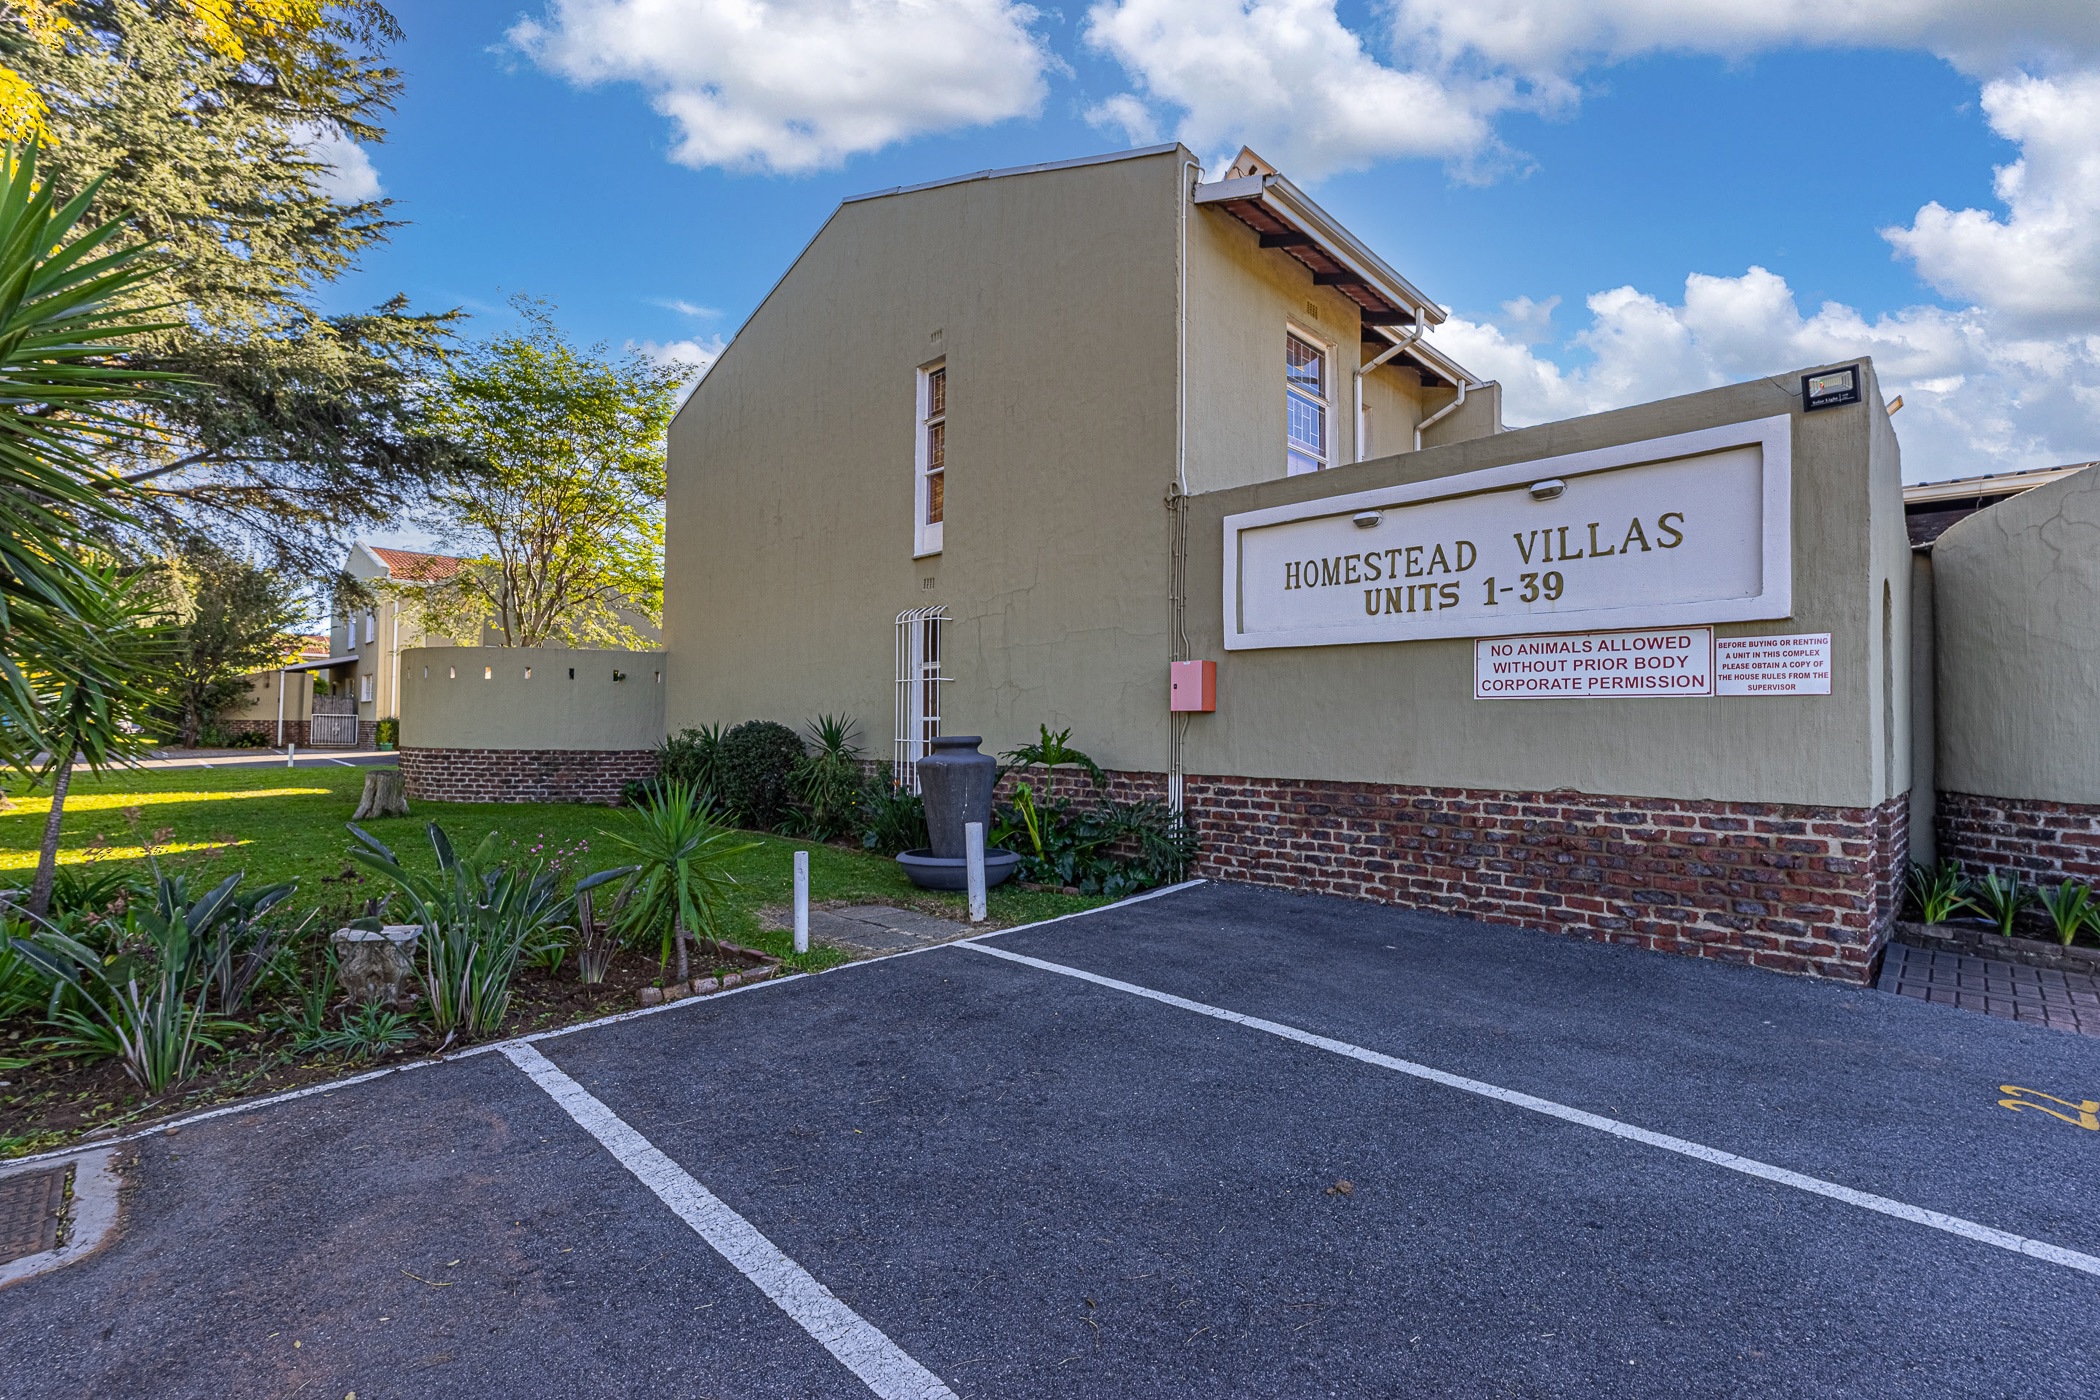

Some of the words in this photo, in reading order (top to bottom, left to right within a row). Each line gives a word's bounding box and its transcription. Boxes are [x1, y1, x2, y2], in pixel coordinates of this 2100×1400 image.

[1285, 540, 1477, 590] HOMESTEAD
[1513, 512, 1684, 564] VILLAS
[1364, 581, 1460, 616] UNITS
[1483, 571, 1564, 606] 1-39
[1491, 644, 1513, 656] NO
[1517, 640, 1592, 655] ANIMALS
[1597, 636, 1691, 652] ALLOWED
[1718, 641, 1747, 649] BEFORE
[1748, 640, 1778, 648] BUYING
[1793, 638, 1829, 646] RENTING
[1782, 649, 1820, 657] COMPLEX
[1493, 660, 1567, 673] WITHOUT
[1573, 658, 1628, 671] PRIOR
[1634, 655, 1689, 669] BODY
[1722, 662, 1750, 670] PLEASE
[1481, 678, 1582, 691] CORPORATE
[1588, 675, 1704, 689] PERMISSION
